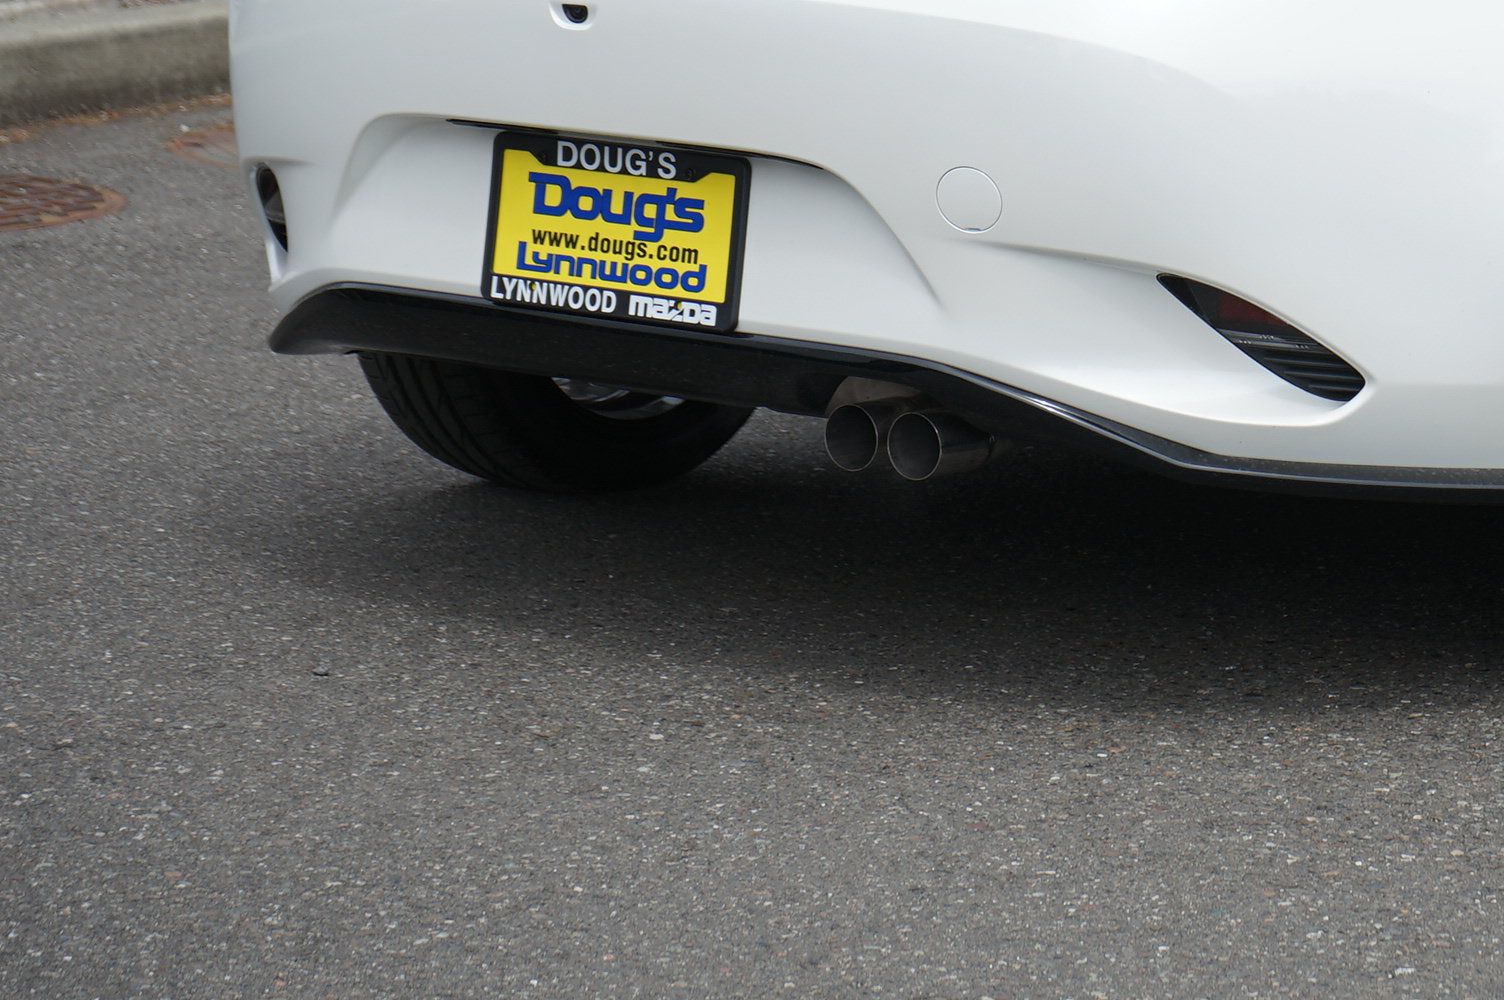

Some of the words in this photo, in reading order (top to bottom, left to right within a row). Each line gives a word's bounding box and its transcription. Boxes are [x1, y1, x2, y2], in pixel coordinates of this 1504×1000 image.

[556, 140, 677, 179] DOUG'S
[528, 171, 705, 242] Doug's
[532, 229, 699, 264] www.dougs.com
[516, 241, 708, 293] Lynnwood
[490, 276, 617, 313] LYNNWOOD
